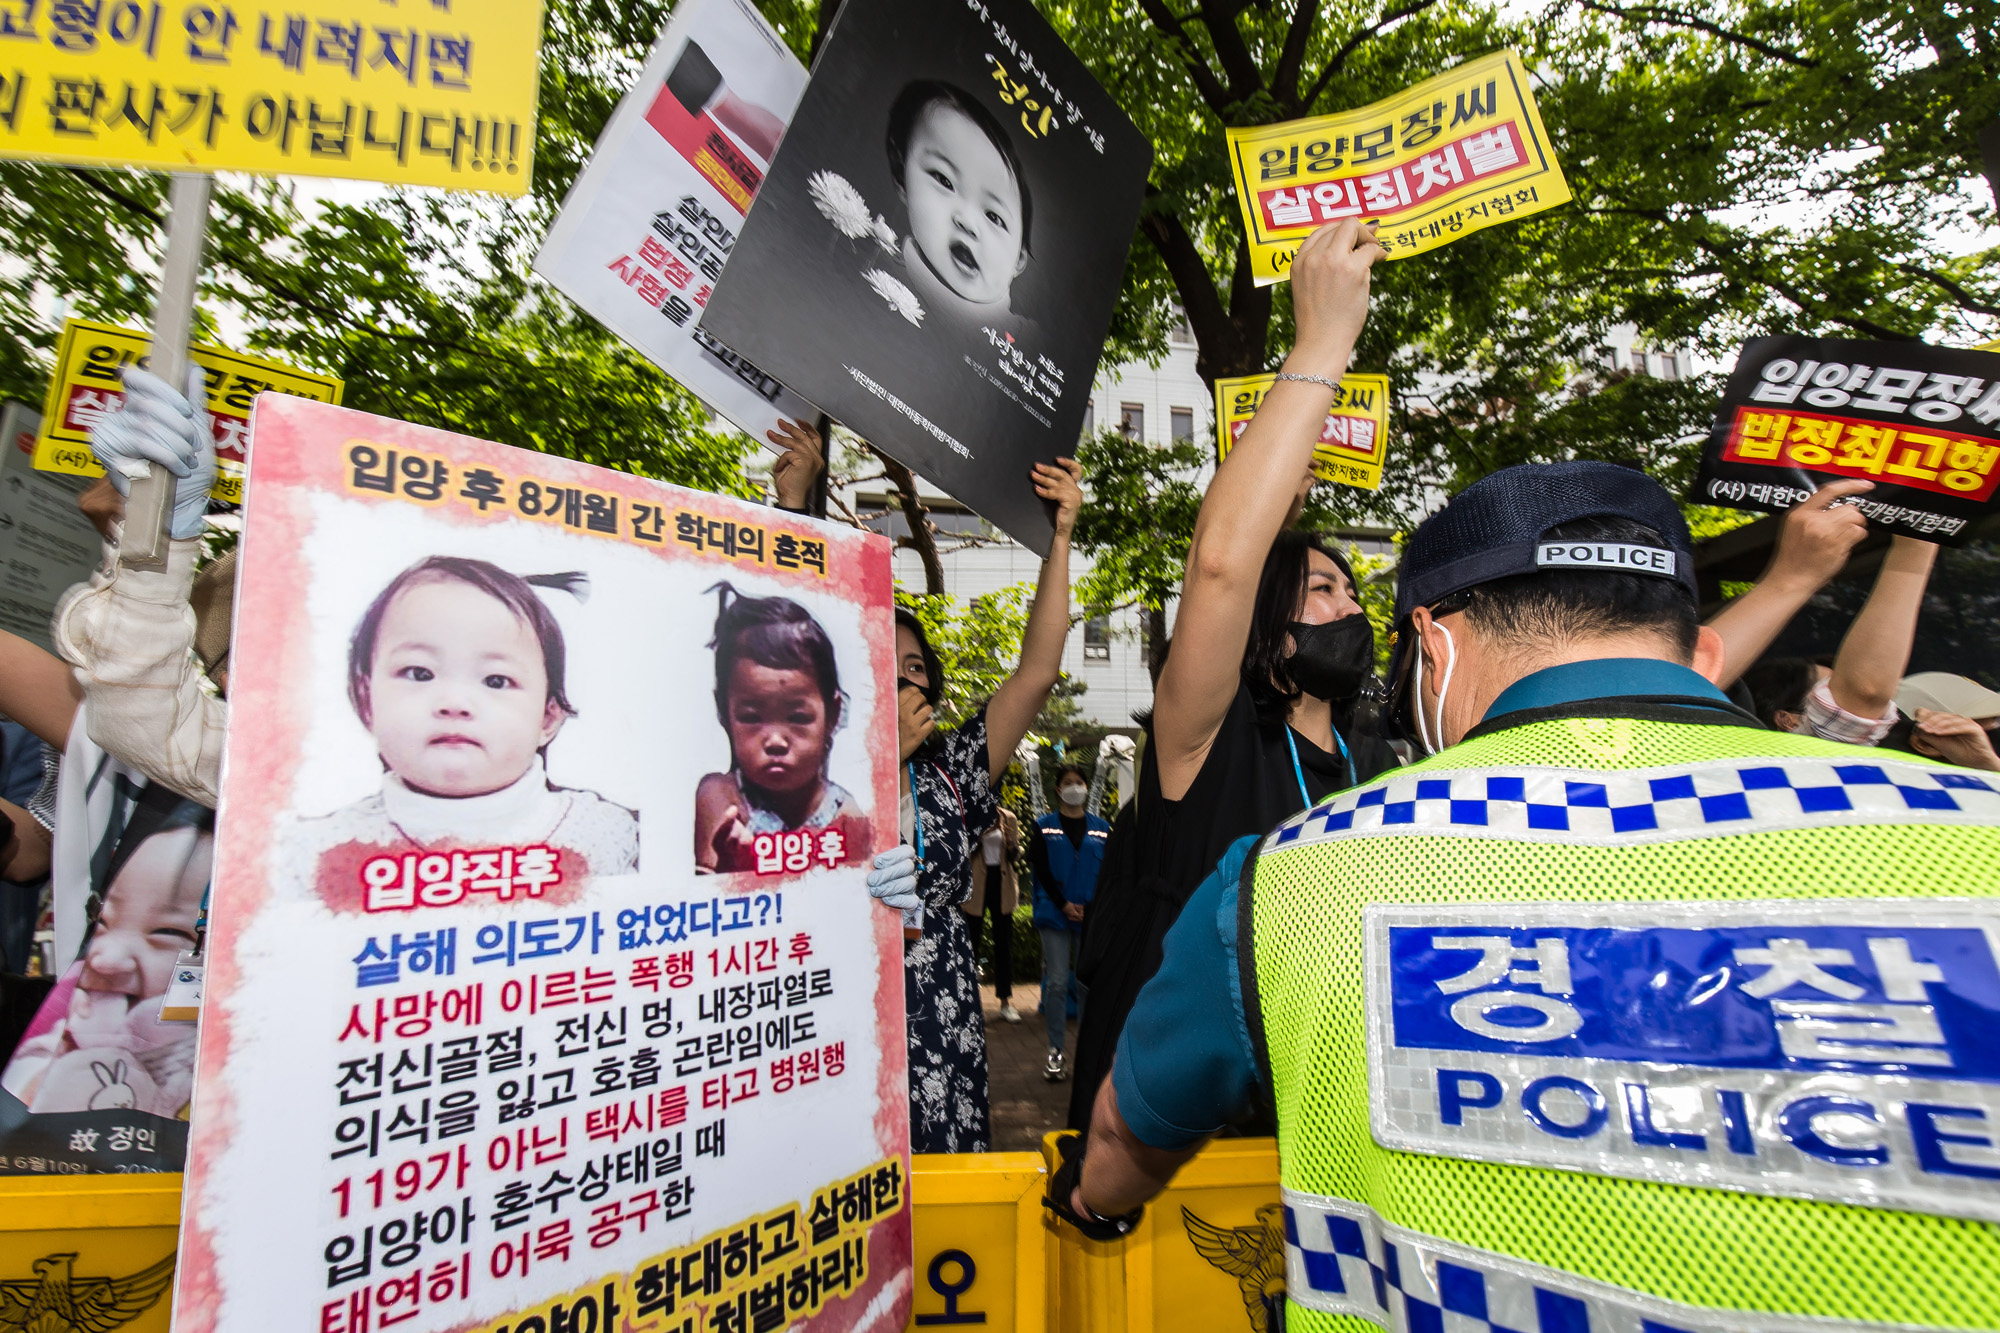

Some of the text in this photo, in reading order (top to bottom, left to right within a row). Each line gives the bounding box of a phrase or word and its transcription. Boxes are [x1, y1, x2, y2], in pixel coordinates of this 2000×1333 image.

[182, 1, 243, 66] 안
[255, 10, 476, 93] 내려지면
[43, 73, 229, 151] 판사가
[240, 90, 523, 175] 아닙니다!!!
[1258, 76, 1499, 184] 입양모장씨
[675, 193, 737, 256] 살인
[1265, 124, 1522, 228] 살인죄처벌
[605, 254, 694, 329] 사형을
[637, 234, 697, 291] 법정
[1737, 411, 2000, 492] 법정최고형
[350, 445, 825, 575] 입양 후 8개월 간 학대의 흔적
[1545, 547, 1665, 569] POLICE
[360, 843, 562, 911] 입양직후
[753, 831, 847, 875] 입양 후
[338, 932, 814, 1043] 사망에 이르는 폭행 1시간 후
[352, 893, 784, 988] 살해 의도가 없었다고?!
[334, 968, 834, 1107] 전신골절, 전신 멍, 내장파열로
[1431, 934, 1957, 1068] 경찰
[330, 1011, 817, 1161] 의식을 잃고 호흡 곤란임에도
[330, 1041, 846, 1219] 119가 아닌 택시를 타고 병원행
[1436, 1066, 2000, 1181] POLICE
[106, 1125, 157, 1153] 정인
[319, 1176, 696, 1333] 태연히 어묵 공구한
[323, 1118, 726, 1290] 입양아 혼수상태일 때
[634, 1209, 800, 1319] 학대하고
[808, 1161, 902, 1246] 살해한
[914, 1248, 987, 1327] 오
